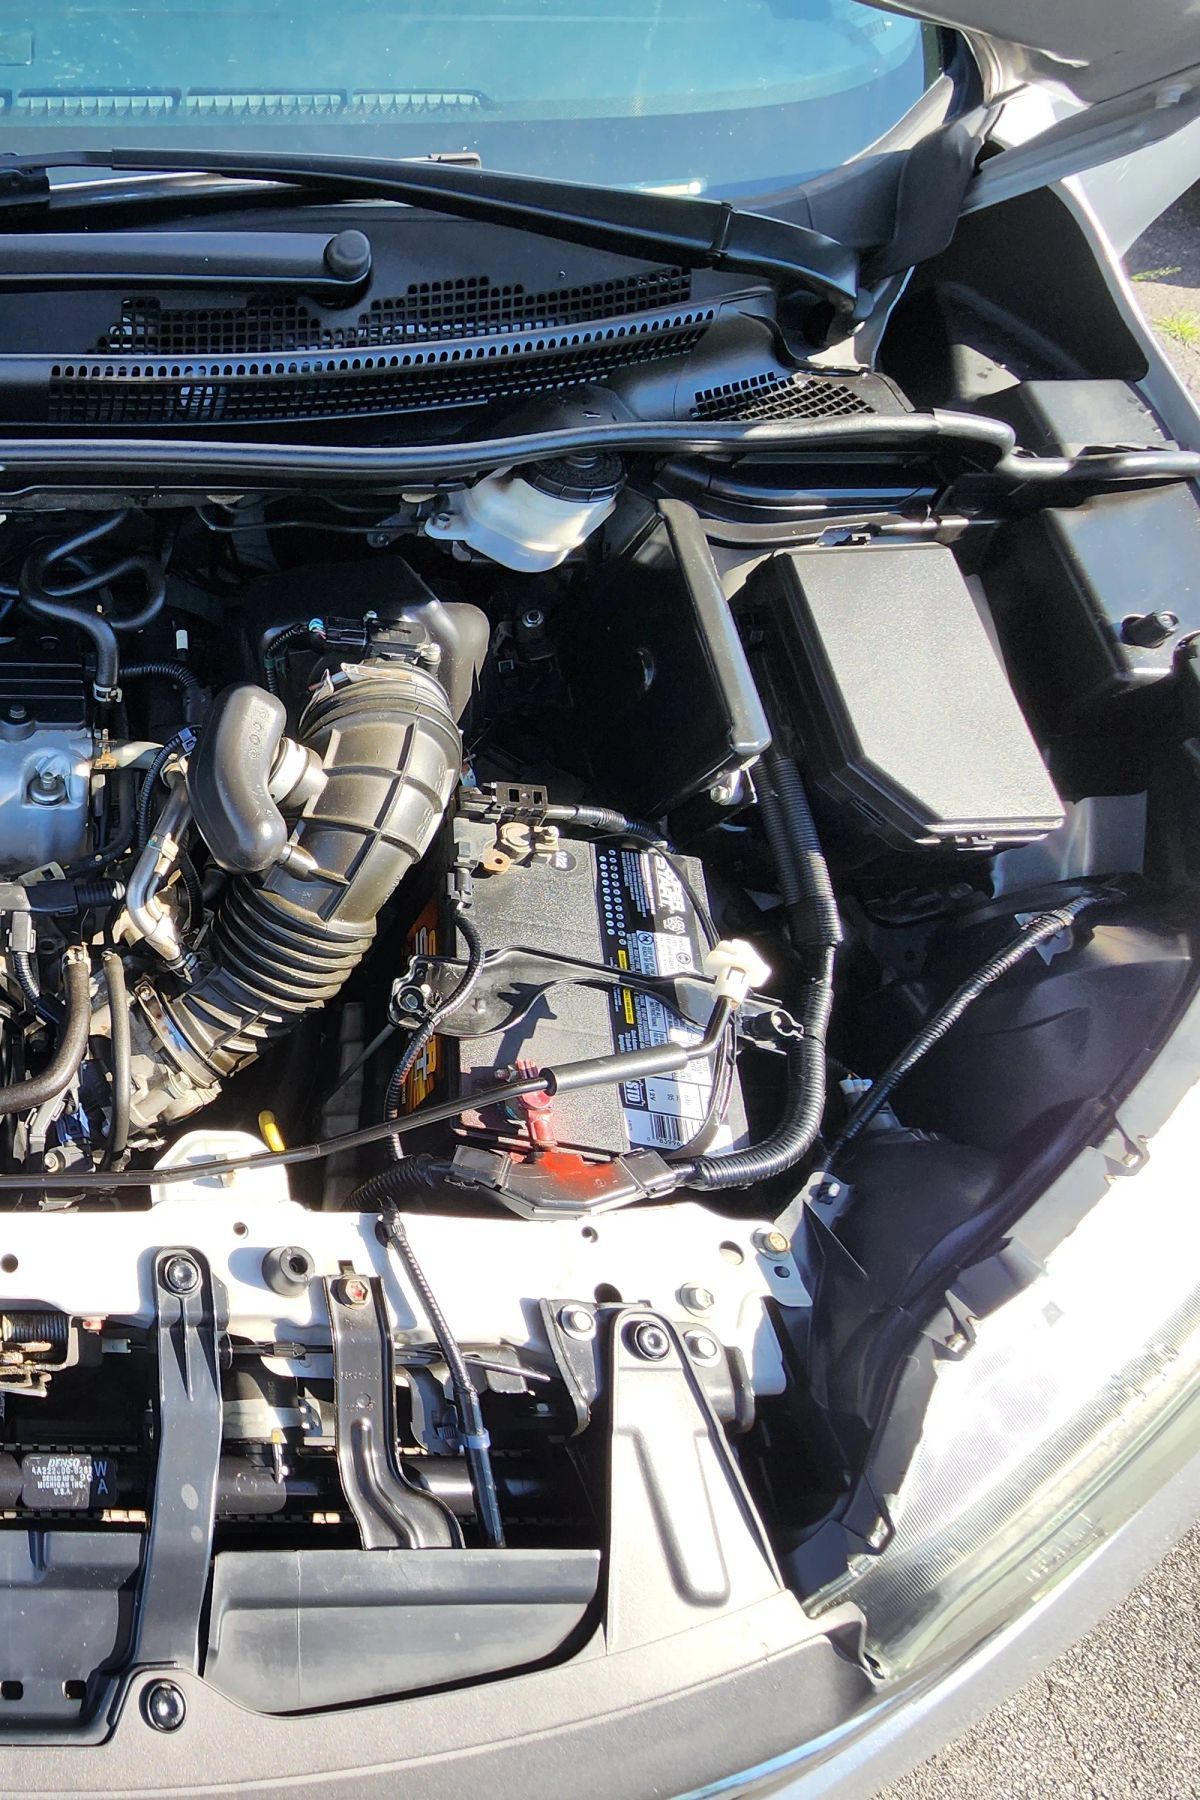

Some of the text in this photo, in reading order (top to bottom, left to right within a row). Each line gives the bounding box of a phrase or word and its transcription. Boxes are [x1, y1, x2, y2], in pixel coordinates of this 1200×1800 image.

[626, 1080, 640, 1103] STD
[648, 1088, 656, 1102] 12V
[48, 1458, 81, 1468] DENSO
[93, 1461, 108, 1477] W
[37, 1481, 86, 1489] MICHIGAN INC.
[97, 1479, 109, 1495] A
